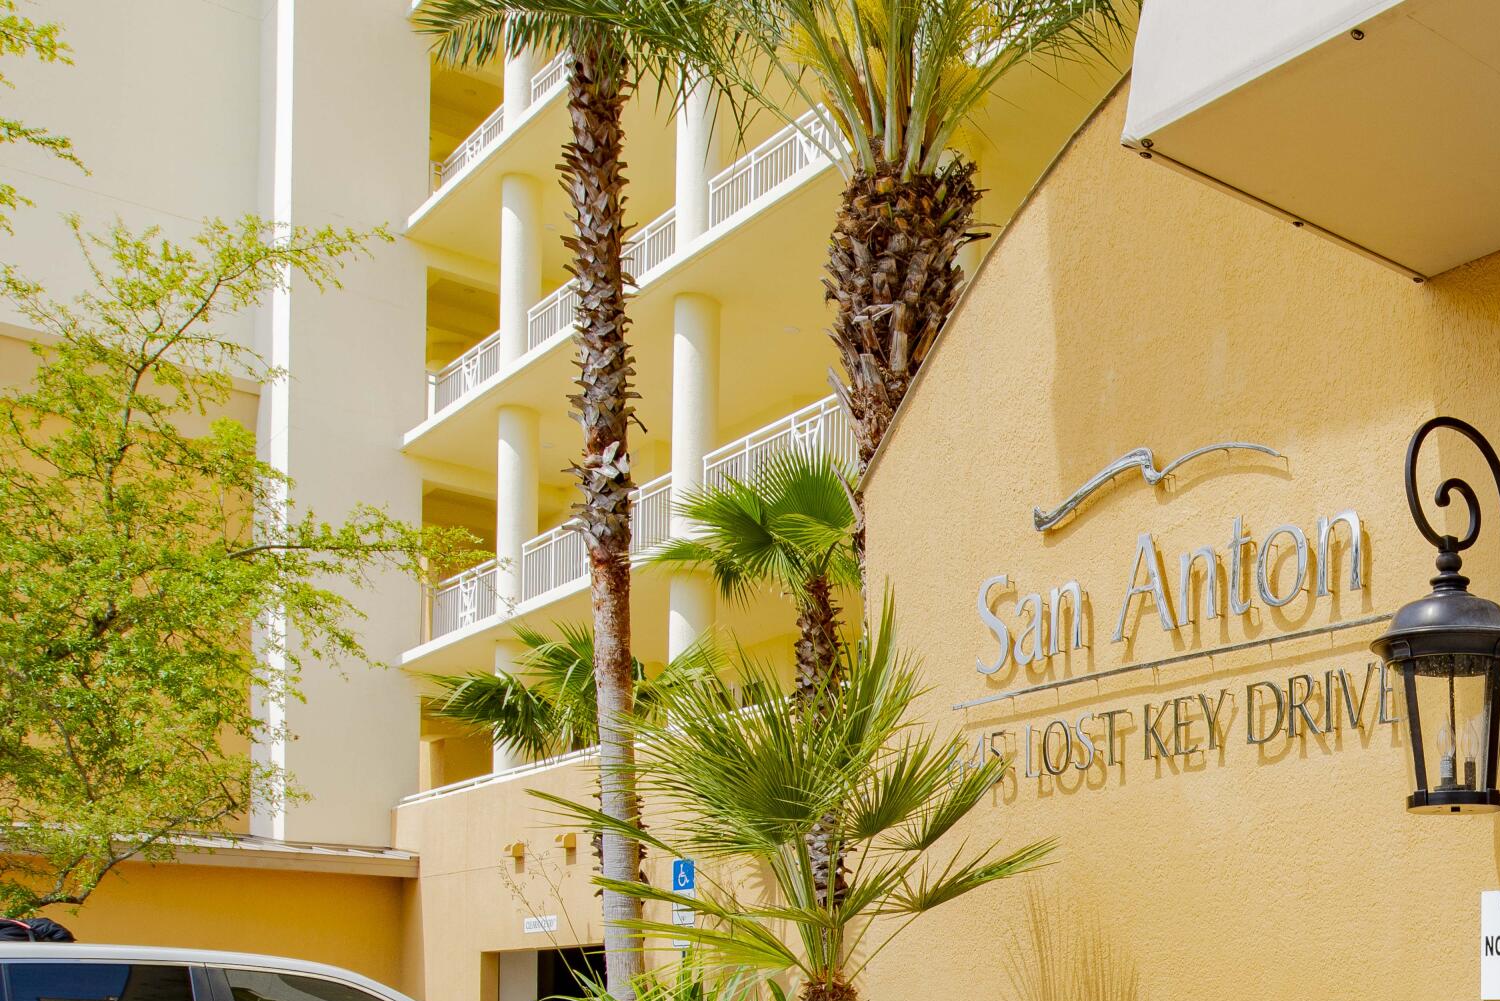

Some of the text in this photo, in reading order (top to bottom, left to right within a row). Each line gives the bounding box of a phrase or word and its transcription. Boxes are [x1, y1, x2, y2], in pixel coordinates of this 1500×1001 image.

[976, 508, 1363, 674] San Anton
[1025, 708, 1129, 778] LOST
[1144, 688, 1229, 761] KEY
[1246, 660, 1403, 745] DRIVE
